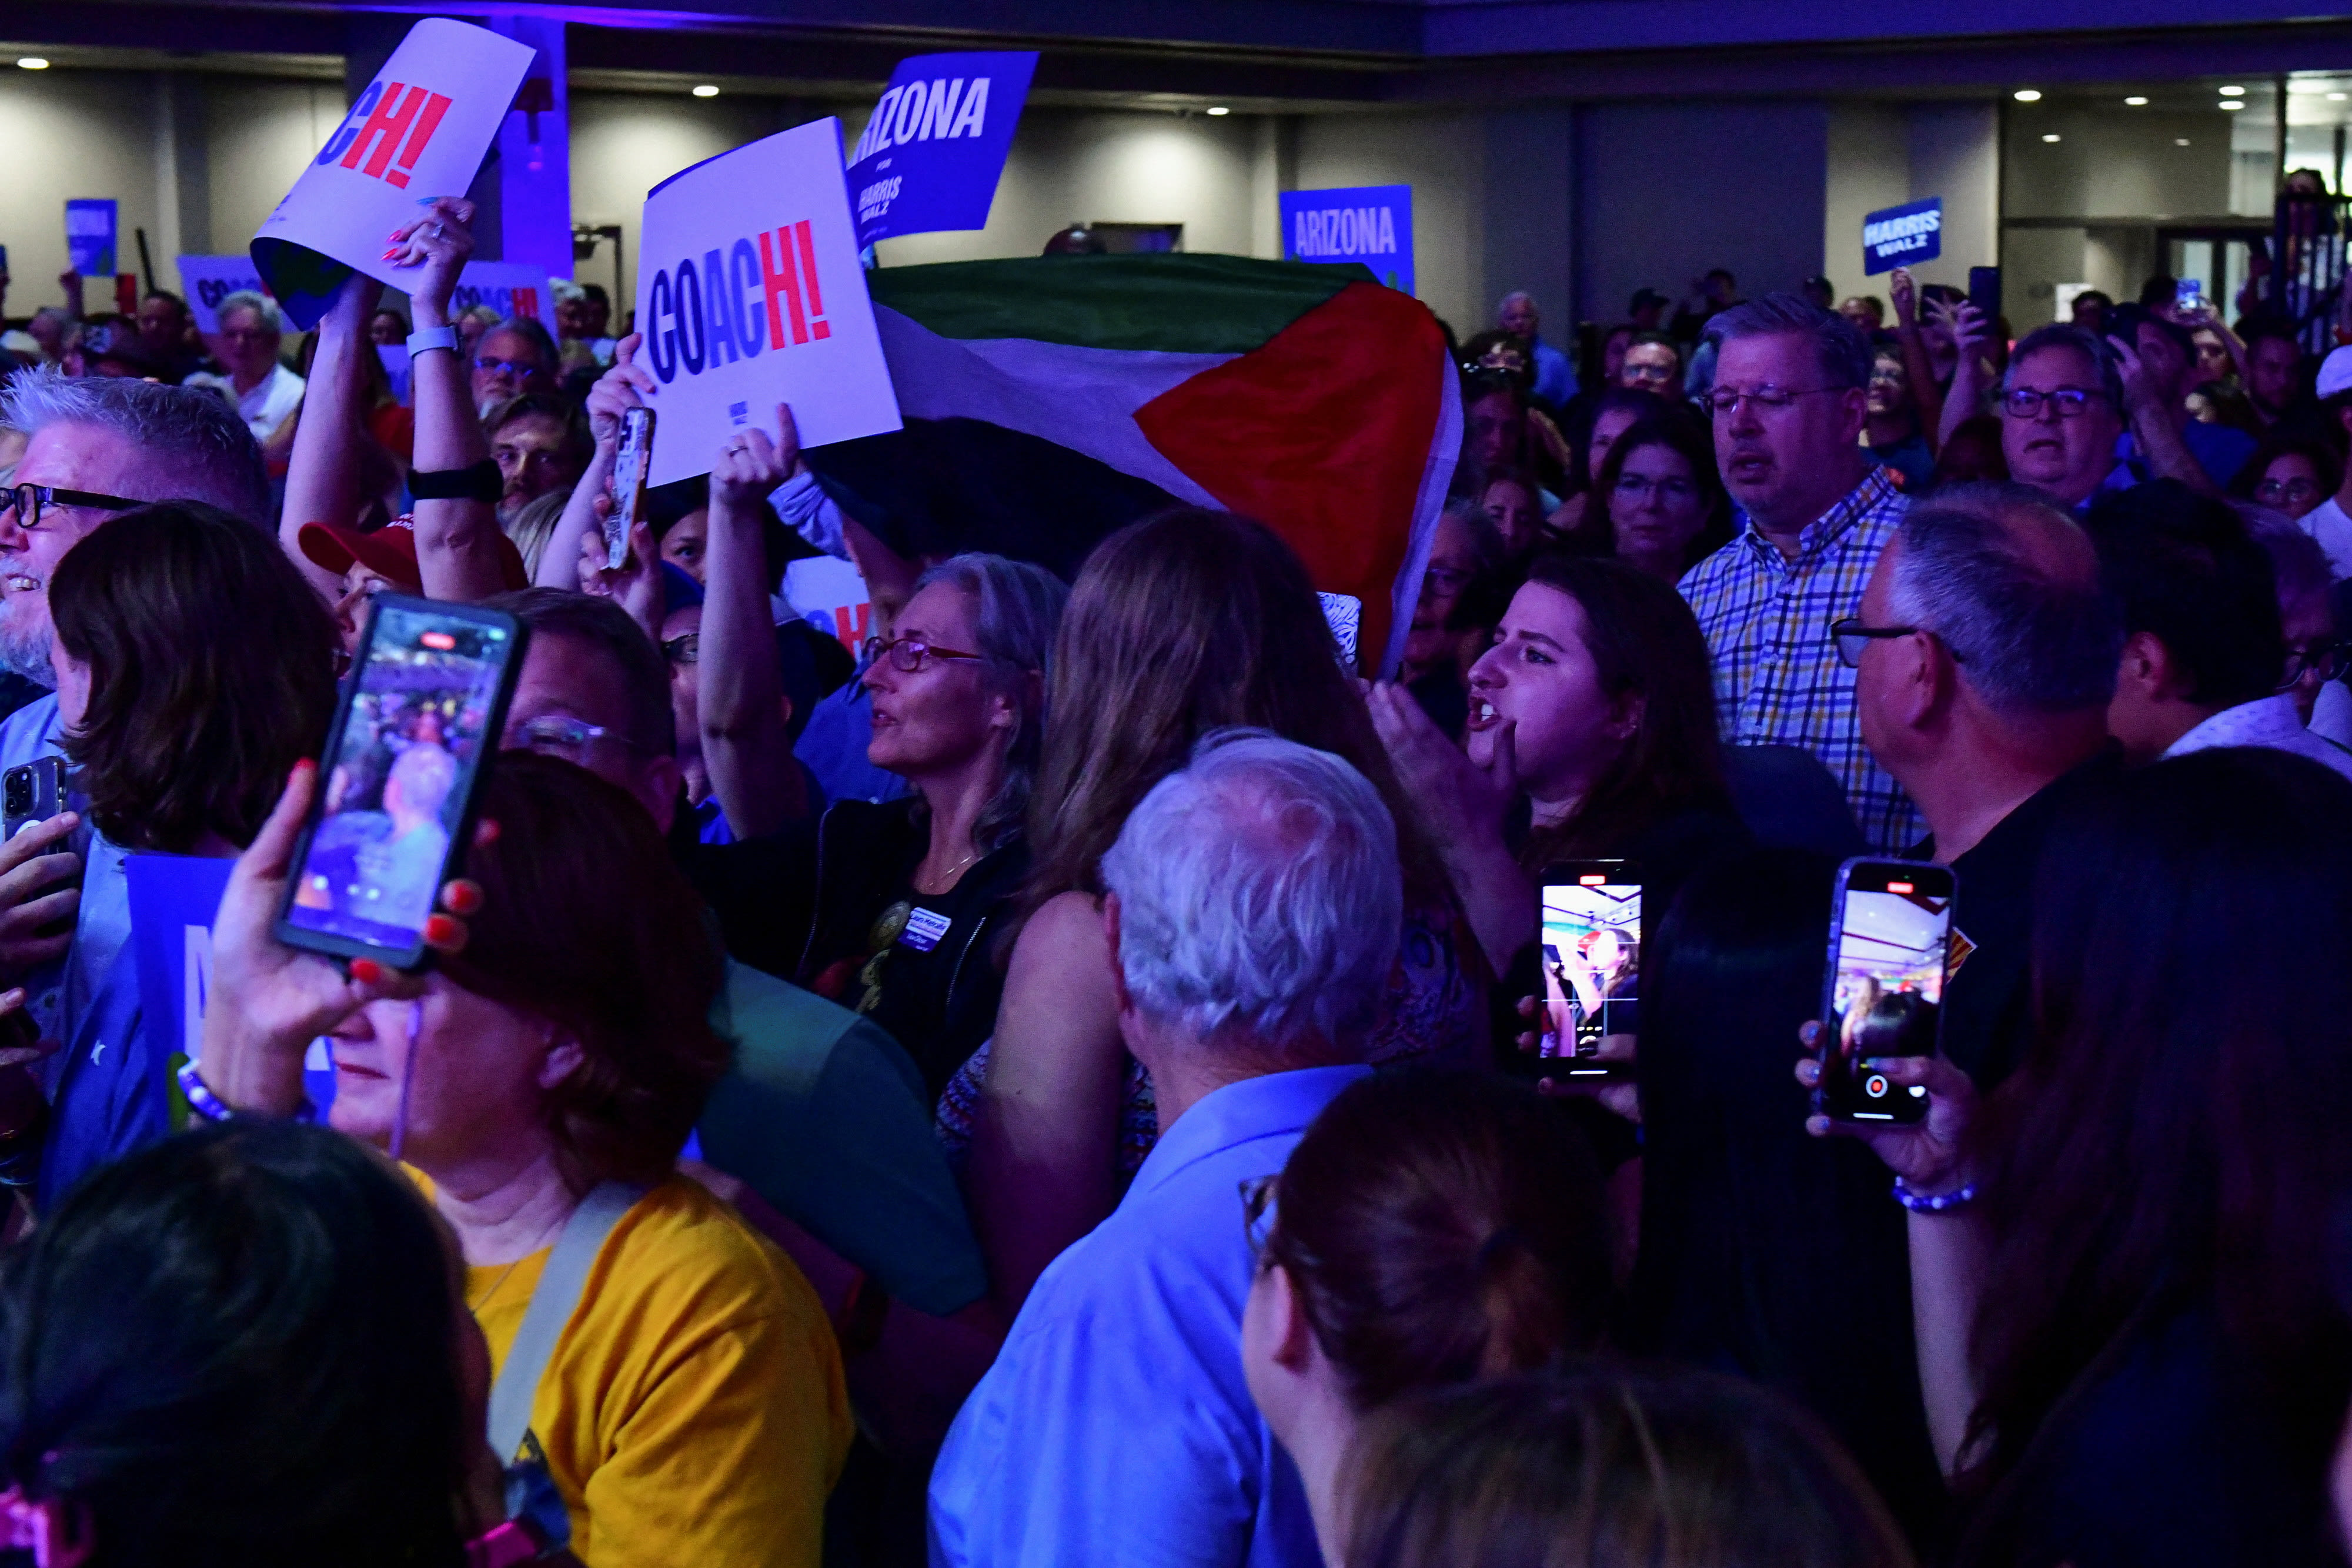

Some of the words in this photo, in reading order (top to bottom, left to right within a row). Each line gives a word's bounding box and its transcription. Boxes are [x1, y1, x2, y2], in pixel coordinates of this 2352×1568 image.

[858, 175, 903, 212] HARRIS
[1295, 206, 1397, 256] ARIZONA
[1864, 209, 1940, 248] HARRIS
[1876, 233, 1927, 257] WALZ
[649, 219, 831, 384] COACH!
